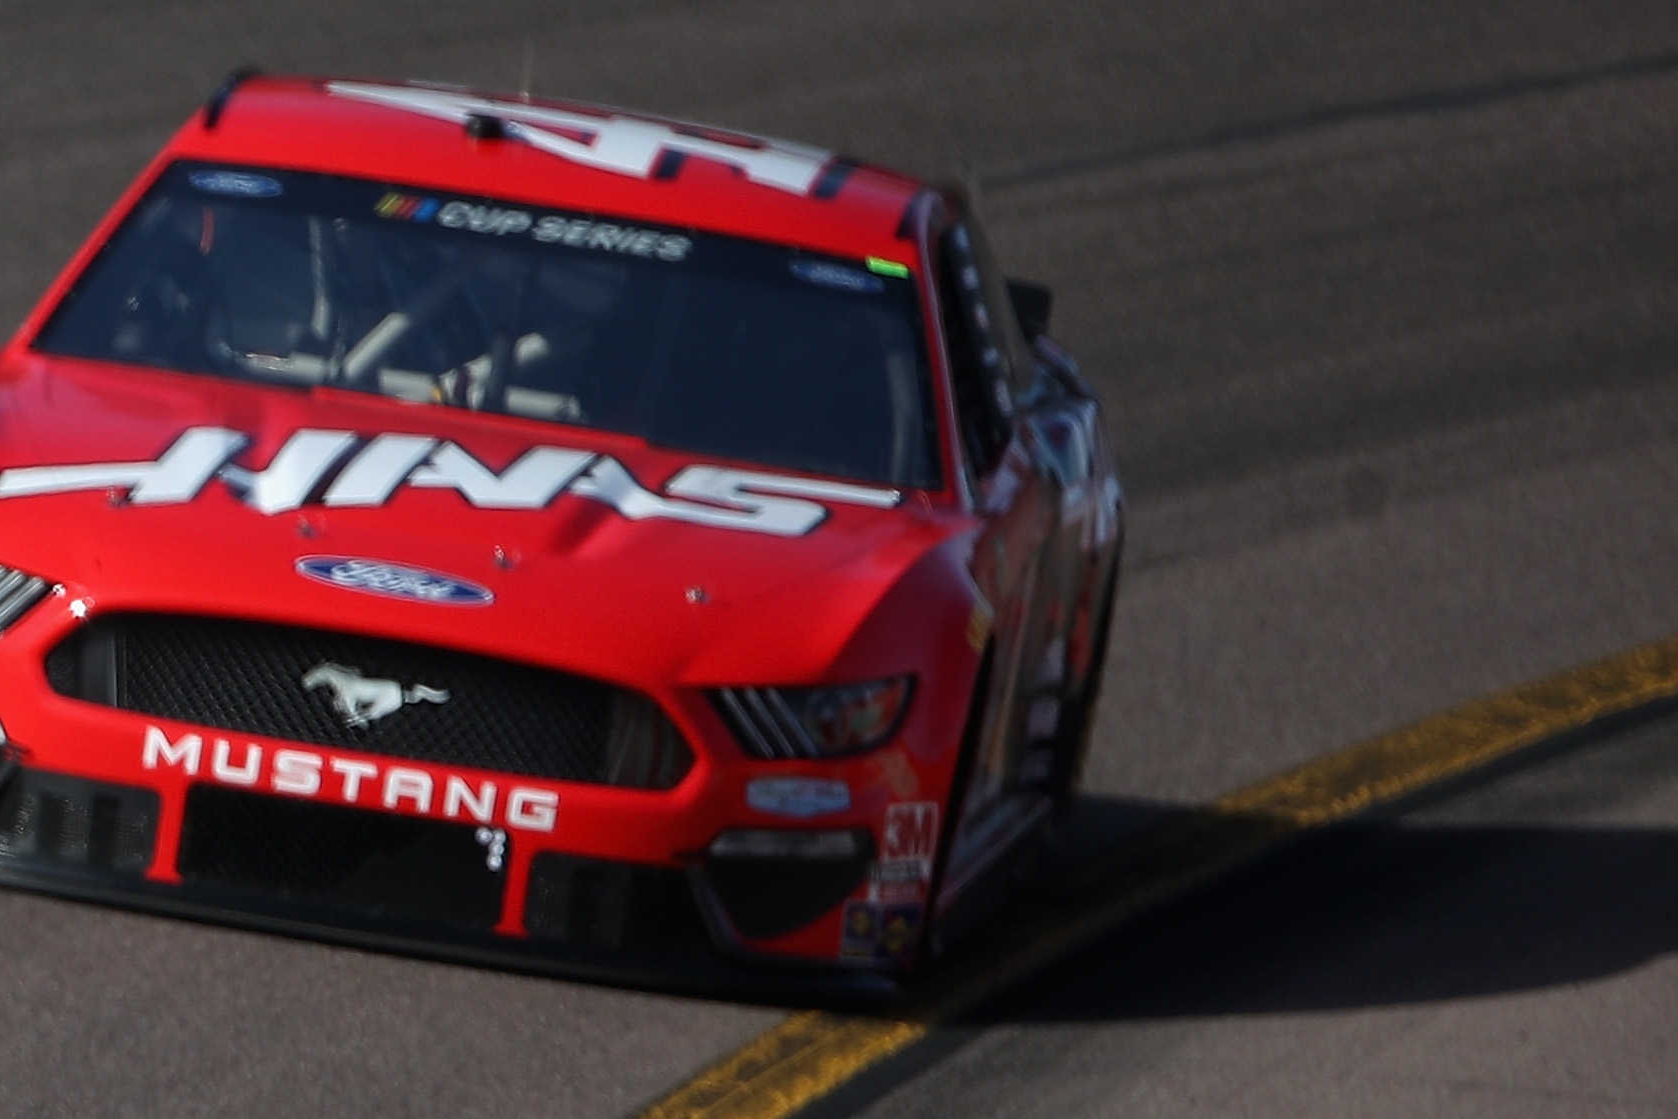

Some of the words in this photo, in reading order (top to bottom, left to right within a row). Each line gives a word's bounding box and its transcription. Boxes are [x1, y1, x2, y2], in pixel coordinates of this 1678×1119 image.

[437, 200, 533, 236] CUP
[531, 215, 692, 262] SERIES
[142, 726, 559, 833] MUSTANG
